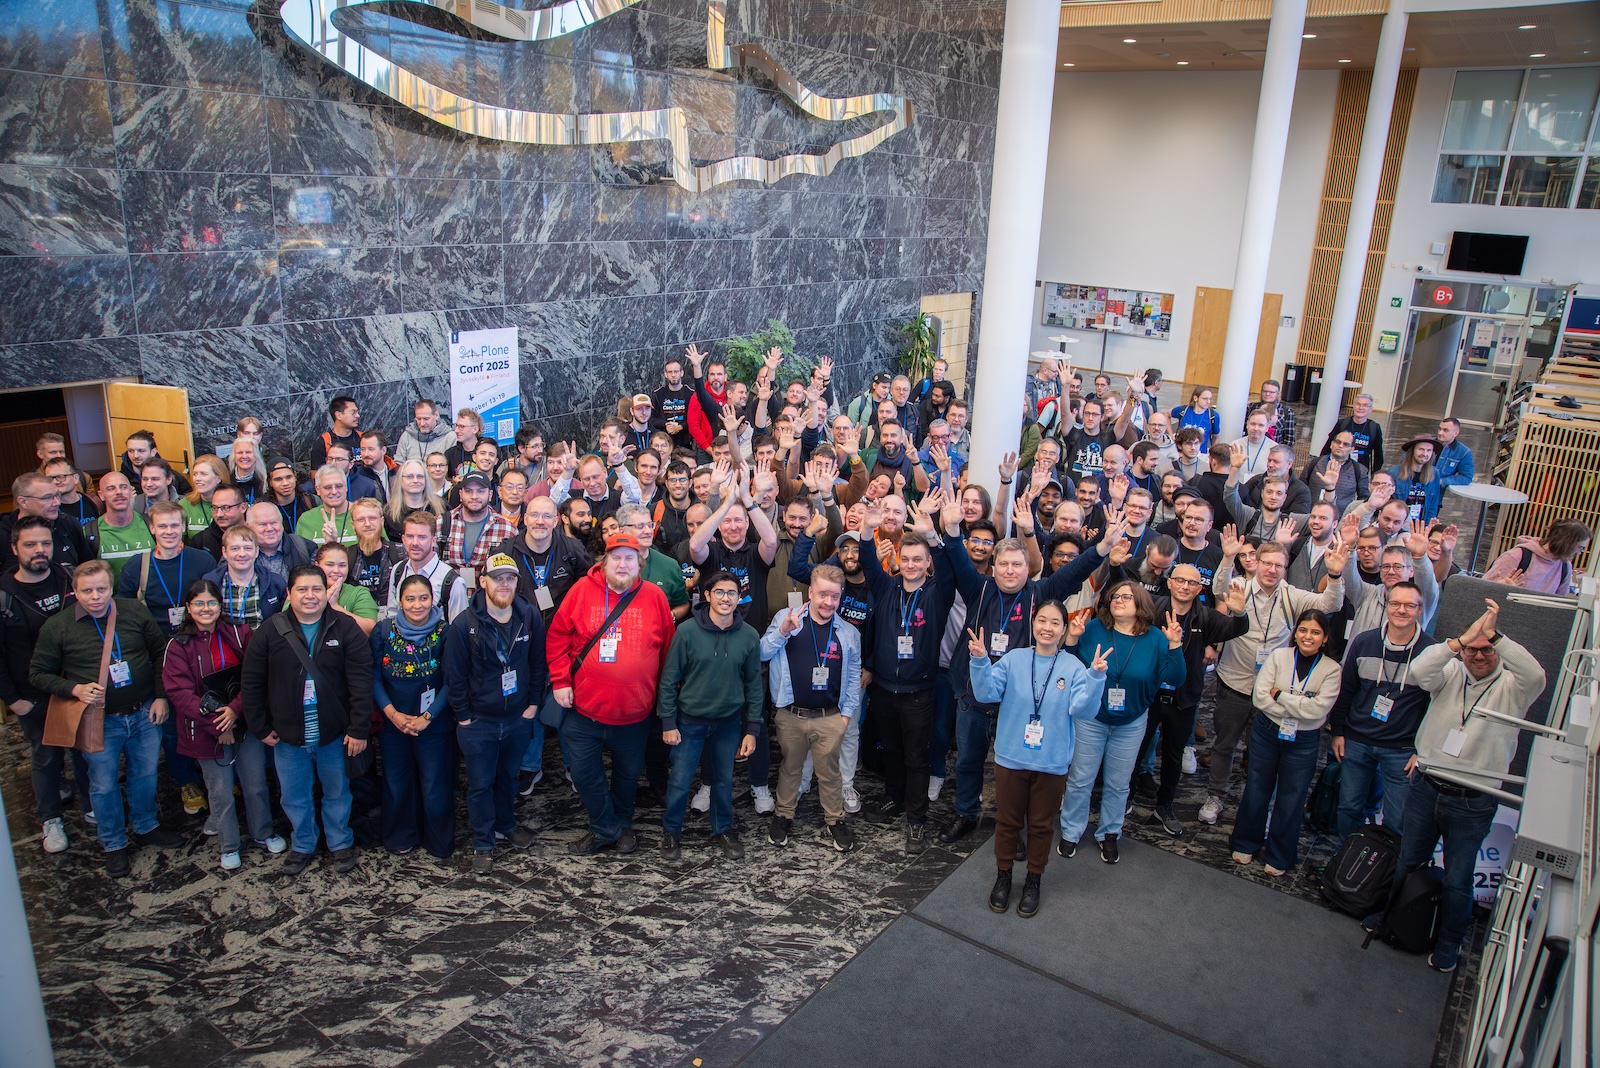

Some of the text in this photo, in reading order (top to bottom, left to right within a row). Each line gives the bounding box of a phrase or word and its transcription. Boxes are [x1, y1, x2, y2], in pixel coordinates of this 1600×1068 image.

[481, 345, 509, 357] Plone
[459, 360, 510, 375] Conf 2025
[490, 372, 510, 380] Finland
[471, 401, 489, 412] tober
